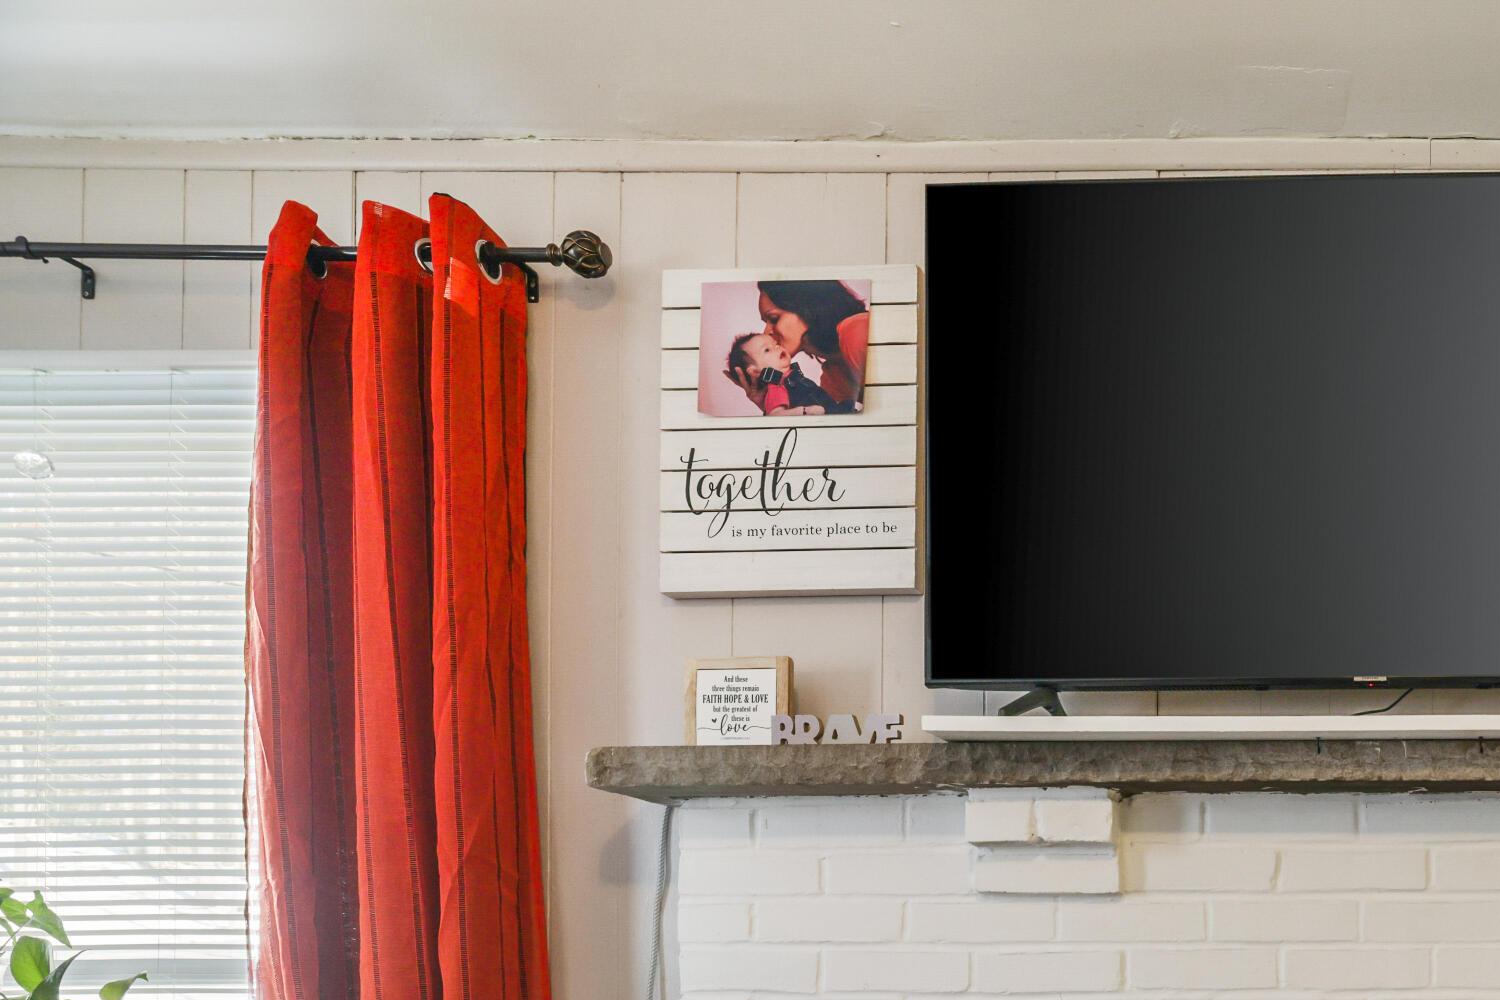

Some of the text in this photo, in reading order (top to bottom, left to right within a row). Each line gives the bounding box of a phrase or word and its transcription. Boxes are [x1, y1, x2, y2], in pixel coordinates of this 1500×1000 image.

[680, 427, 846, 538] together
[731, 521, 898, 539] is my favorite place to be
[724, 675, 748, 683] And these
[726, 685, 741, 693] things
[702, 694, 768, 703] FAITH HOPE & LOVE
[731, 705, 751, 713] greatest
[720, 713, 750, 736] love
[771, 714, 903, 745] BRAVE
